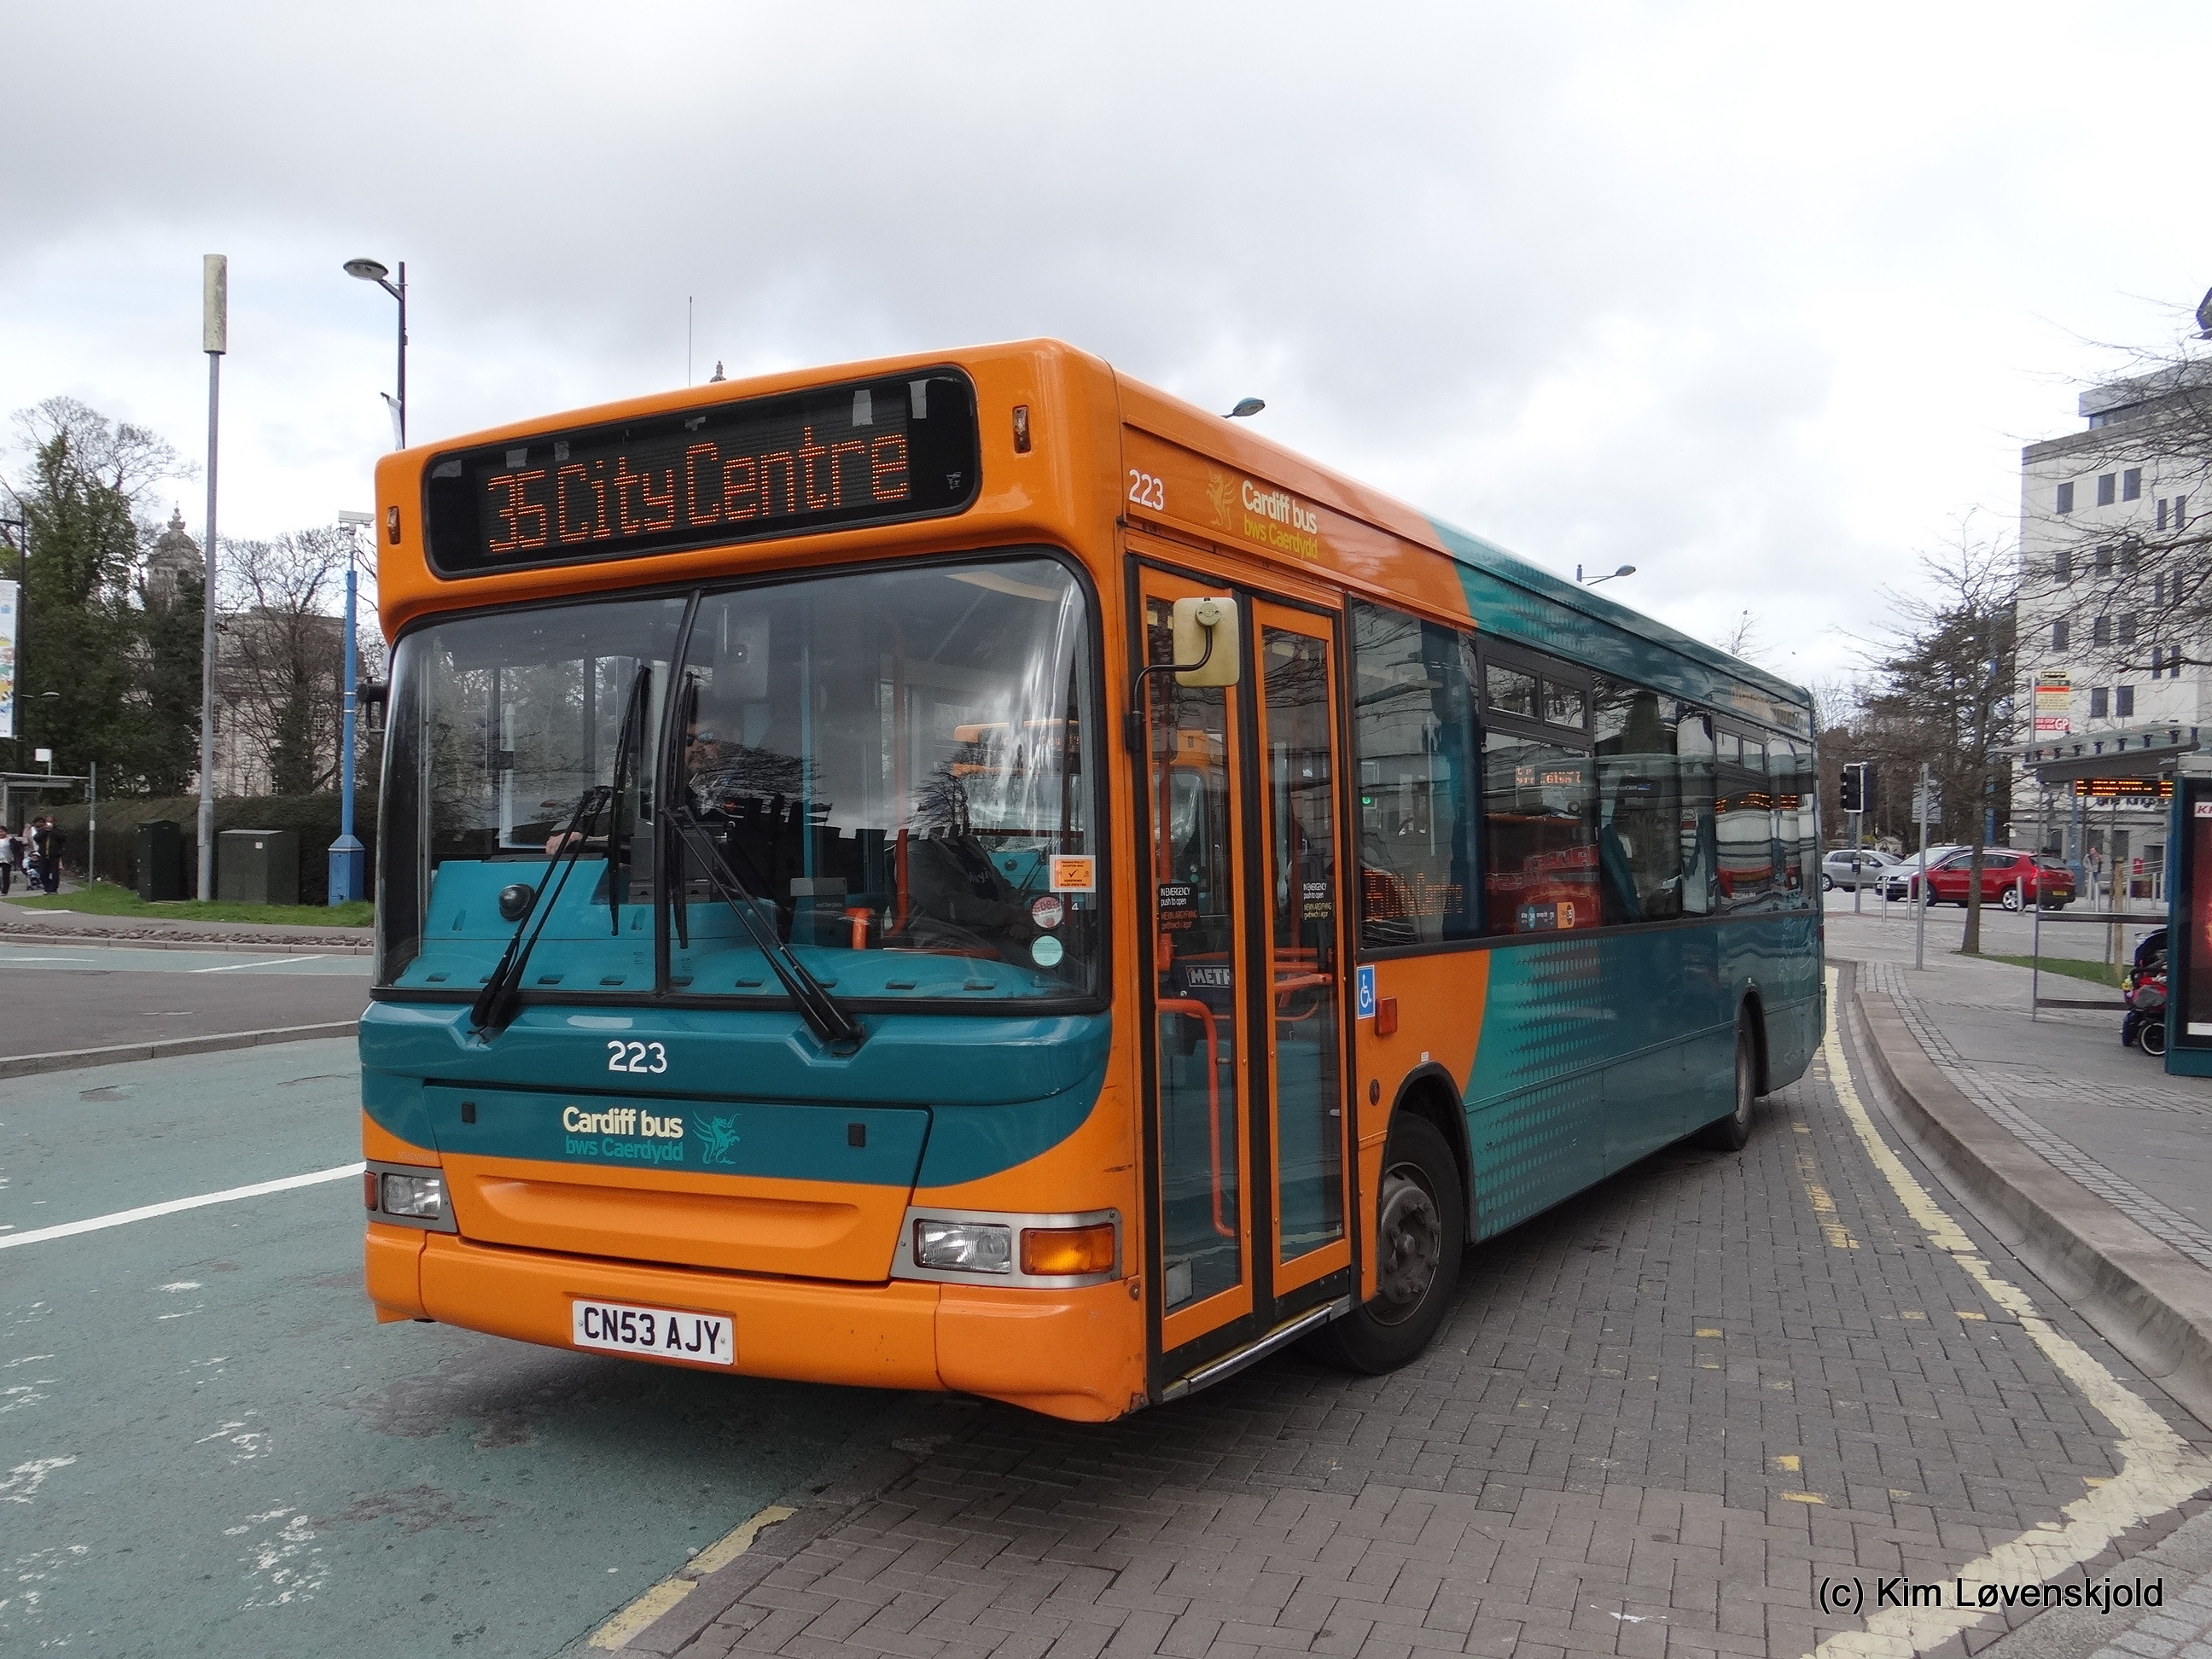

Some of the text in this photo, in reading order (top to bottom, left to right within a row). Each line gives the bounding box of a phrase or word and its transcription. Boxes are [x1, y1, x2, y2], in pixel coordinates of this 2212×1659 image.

[487, 426, 910, 553] 35 City Centre
[1128, 469, 1164, 511] 223
[1242, 480, 1318, 535] Cardiff bus
[1243, 515, 1318, 561] bws Caerdydd
[1161, 898, 1171, 907] push
[1176, 898, 1187, 906] open
[1165, 888, 1190, 896] EMERGENCY
[1190, 968, 1230, 985] METR
[608, 1040, 667, 1074] 223
[563, 1106, 684, 1138] Cardiff bus
[565, 1136, 684, 1165] bws Caerdydd
[584, 1307, 720, 1354] CN53 AJY
